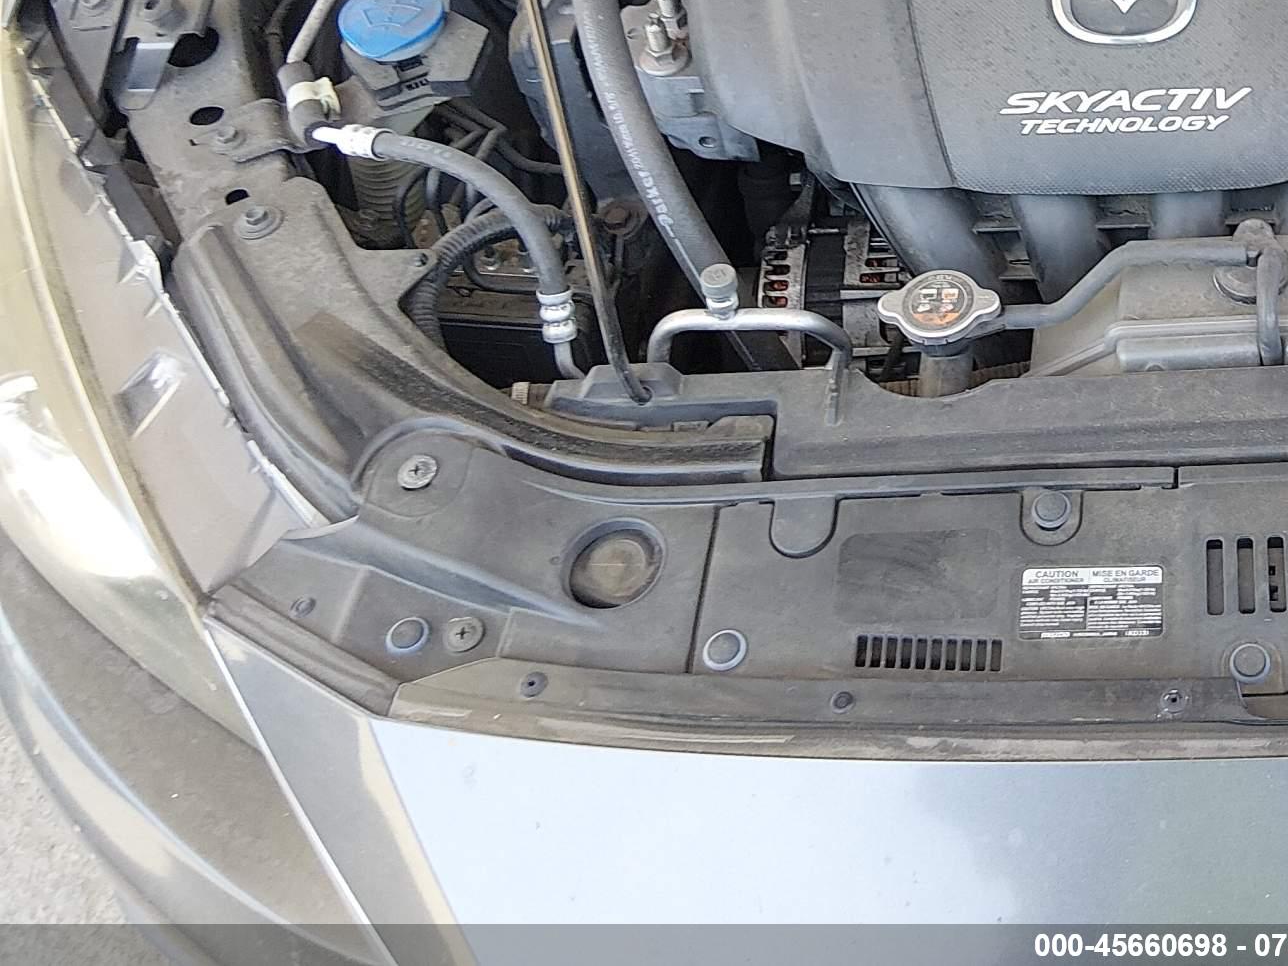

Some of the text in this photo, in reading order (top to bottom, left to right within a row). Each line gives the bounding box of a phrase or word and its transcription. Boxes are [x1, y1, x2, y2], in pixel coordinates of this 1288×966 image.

[999, 87, 1252, 115] SKYACTIV
[1020, 114, 1229, 135] TECHNOLOGY
[1035, 570, 1079, 579] CAUTION
[1129, 569, 1159, 577] GARDE
